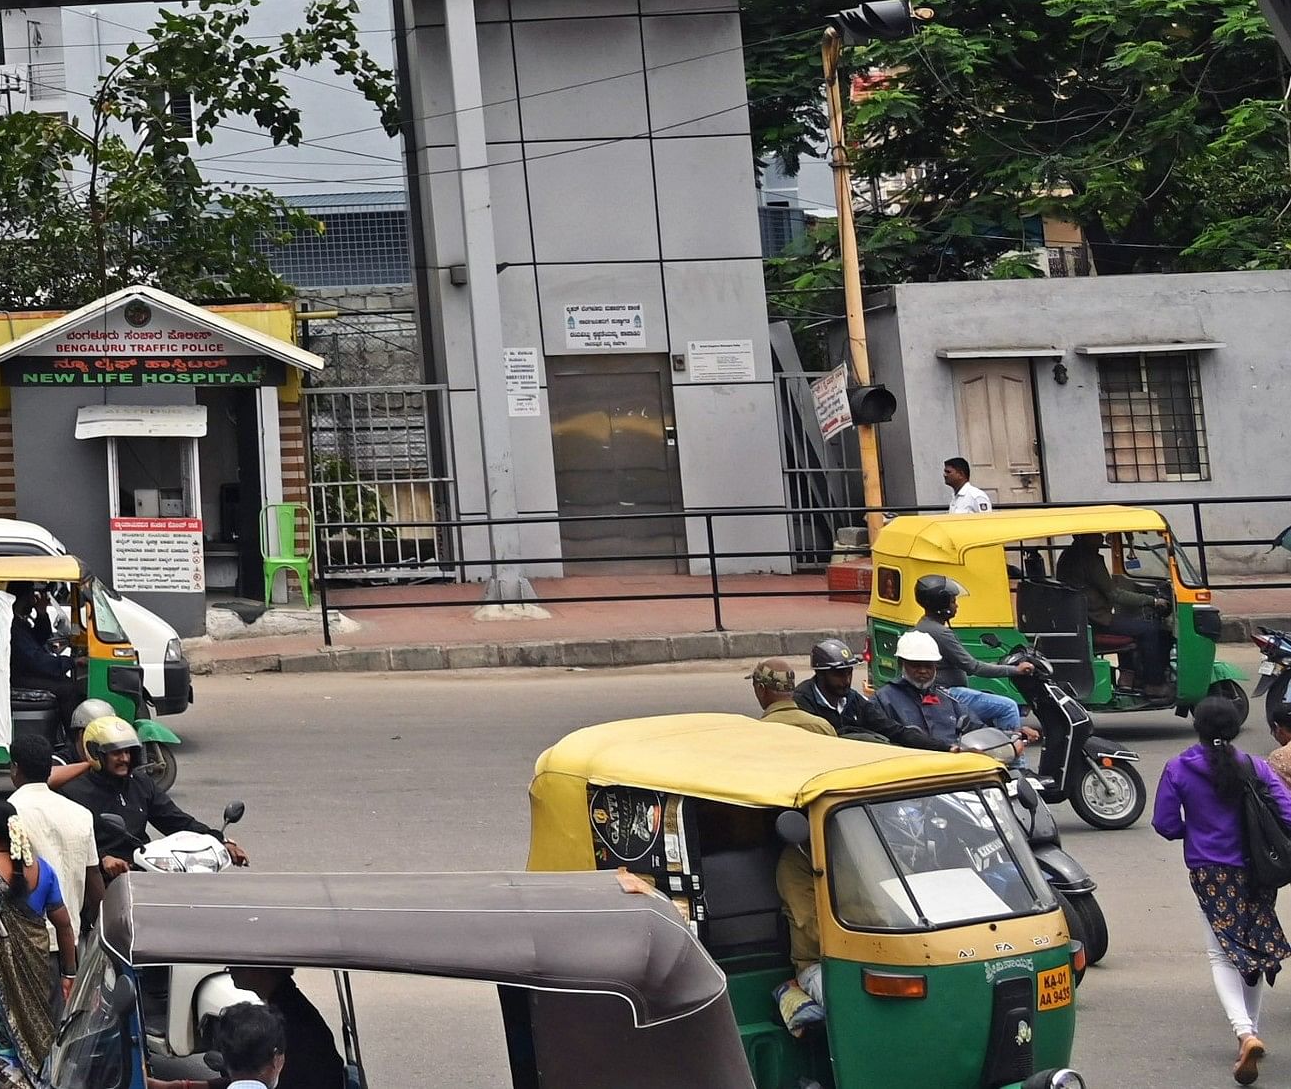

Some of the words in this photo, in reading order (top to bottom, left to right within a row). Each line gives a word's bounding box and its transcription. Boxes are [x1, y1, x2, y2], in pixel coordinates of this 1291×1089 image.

[56, 343, 126, 353] BENGALURU
[130, 343, 178, 352] TRAFFIC
[182, 343, 224, 352] POLICE
[22, 373, 76, 383] NEW
[82, 373, 134, 383] LIFE
[141, 372, 260, 383] HOSPITAL
[1044, 971, 1067, 989] KA-01
[1039, 994, 1052, 1007] AA
[1053, 986, 1070, 1004] 9435
